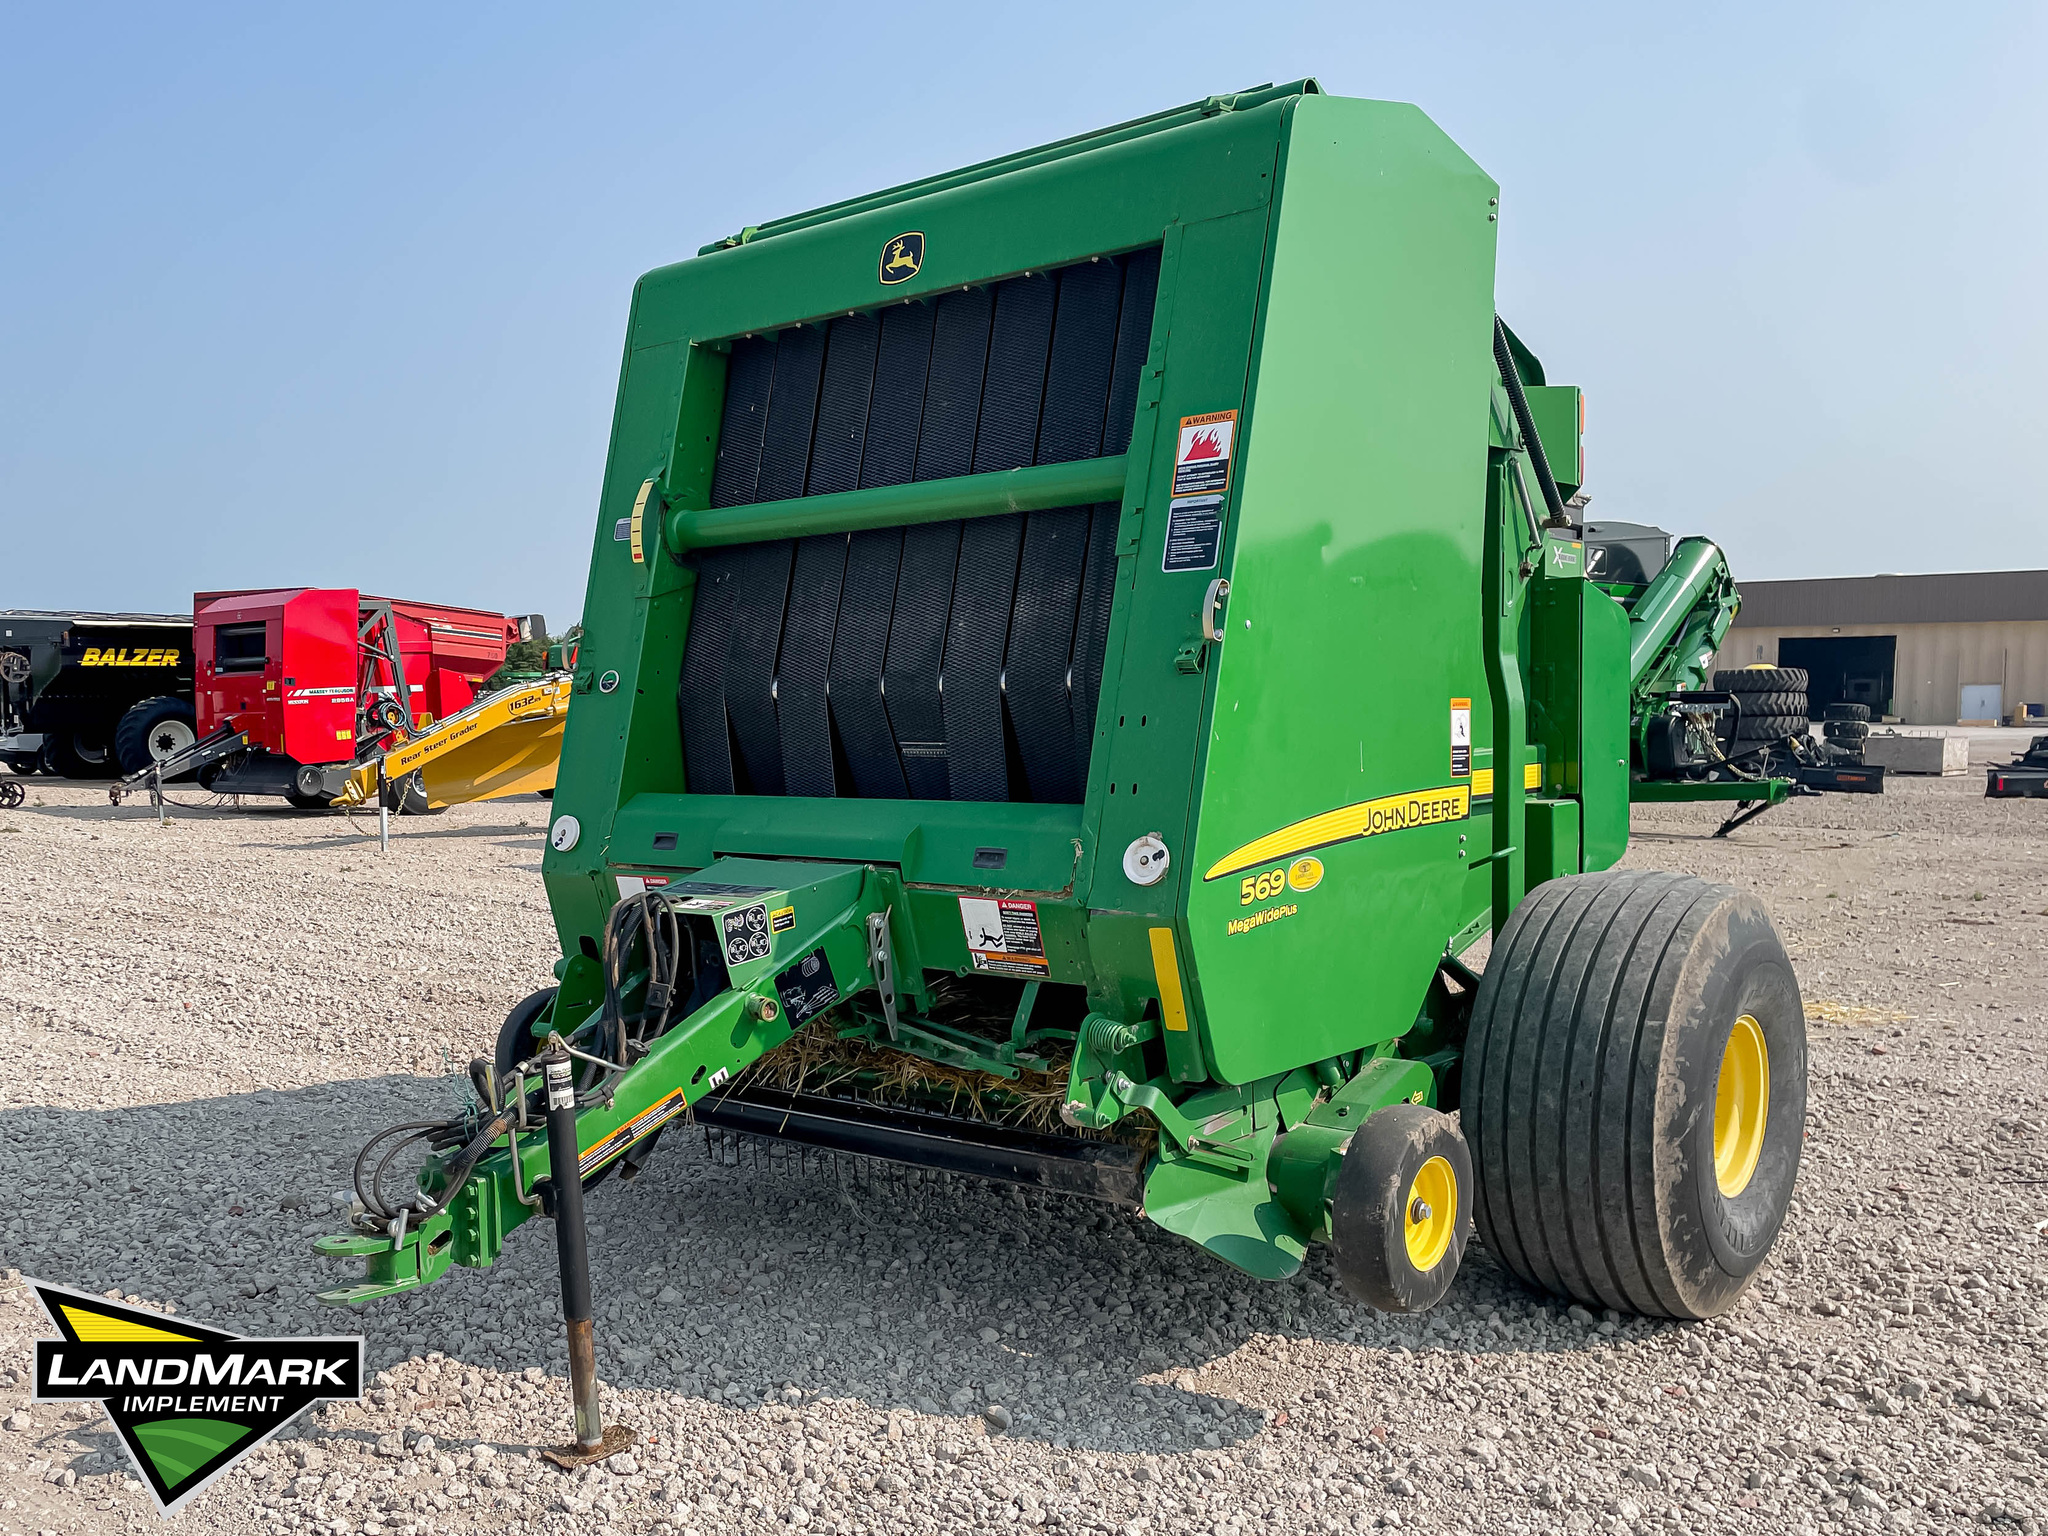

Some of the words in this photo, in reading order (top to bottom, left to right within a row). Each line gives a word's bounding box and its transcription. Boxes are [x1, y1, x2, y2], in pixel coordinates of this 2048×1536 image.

[1192, 411, 1232, 425] WARNING
[80, 647, 180, 667] BALZER
[400, 750, 422, 766] Rear
[423, 737, 448, 755] Steer
[449, 722, 479, 741] Grader
[1362, 805, 1406, 832] JOHN
[1408, 798, 1461, 823] DEERE
[1240, 867, 1287, 906] 569
[1007, 902, 1032, 911] DANGER
[1227, 903, 1299, 937] MegaWidePlus
